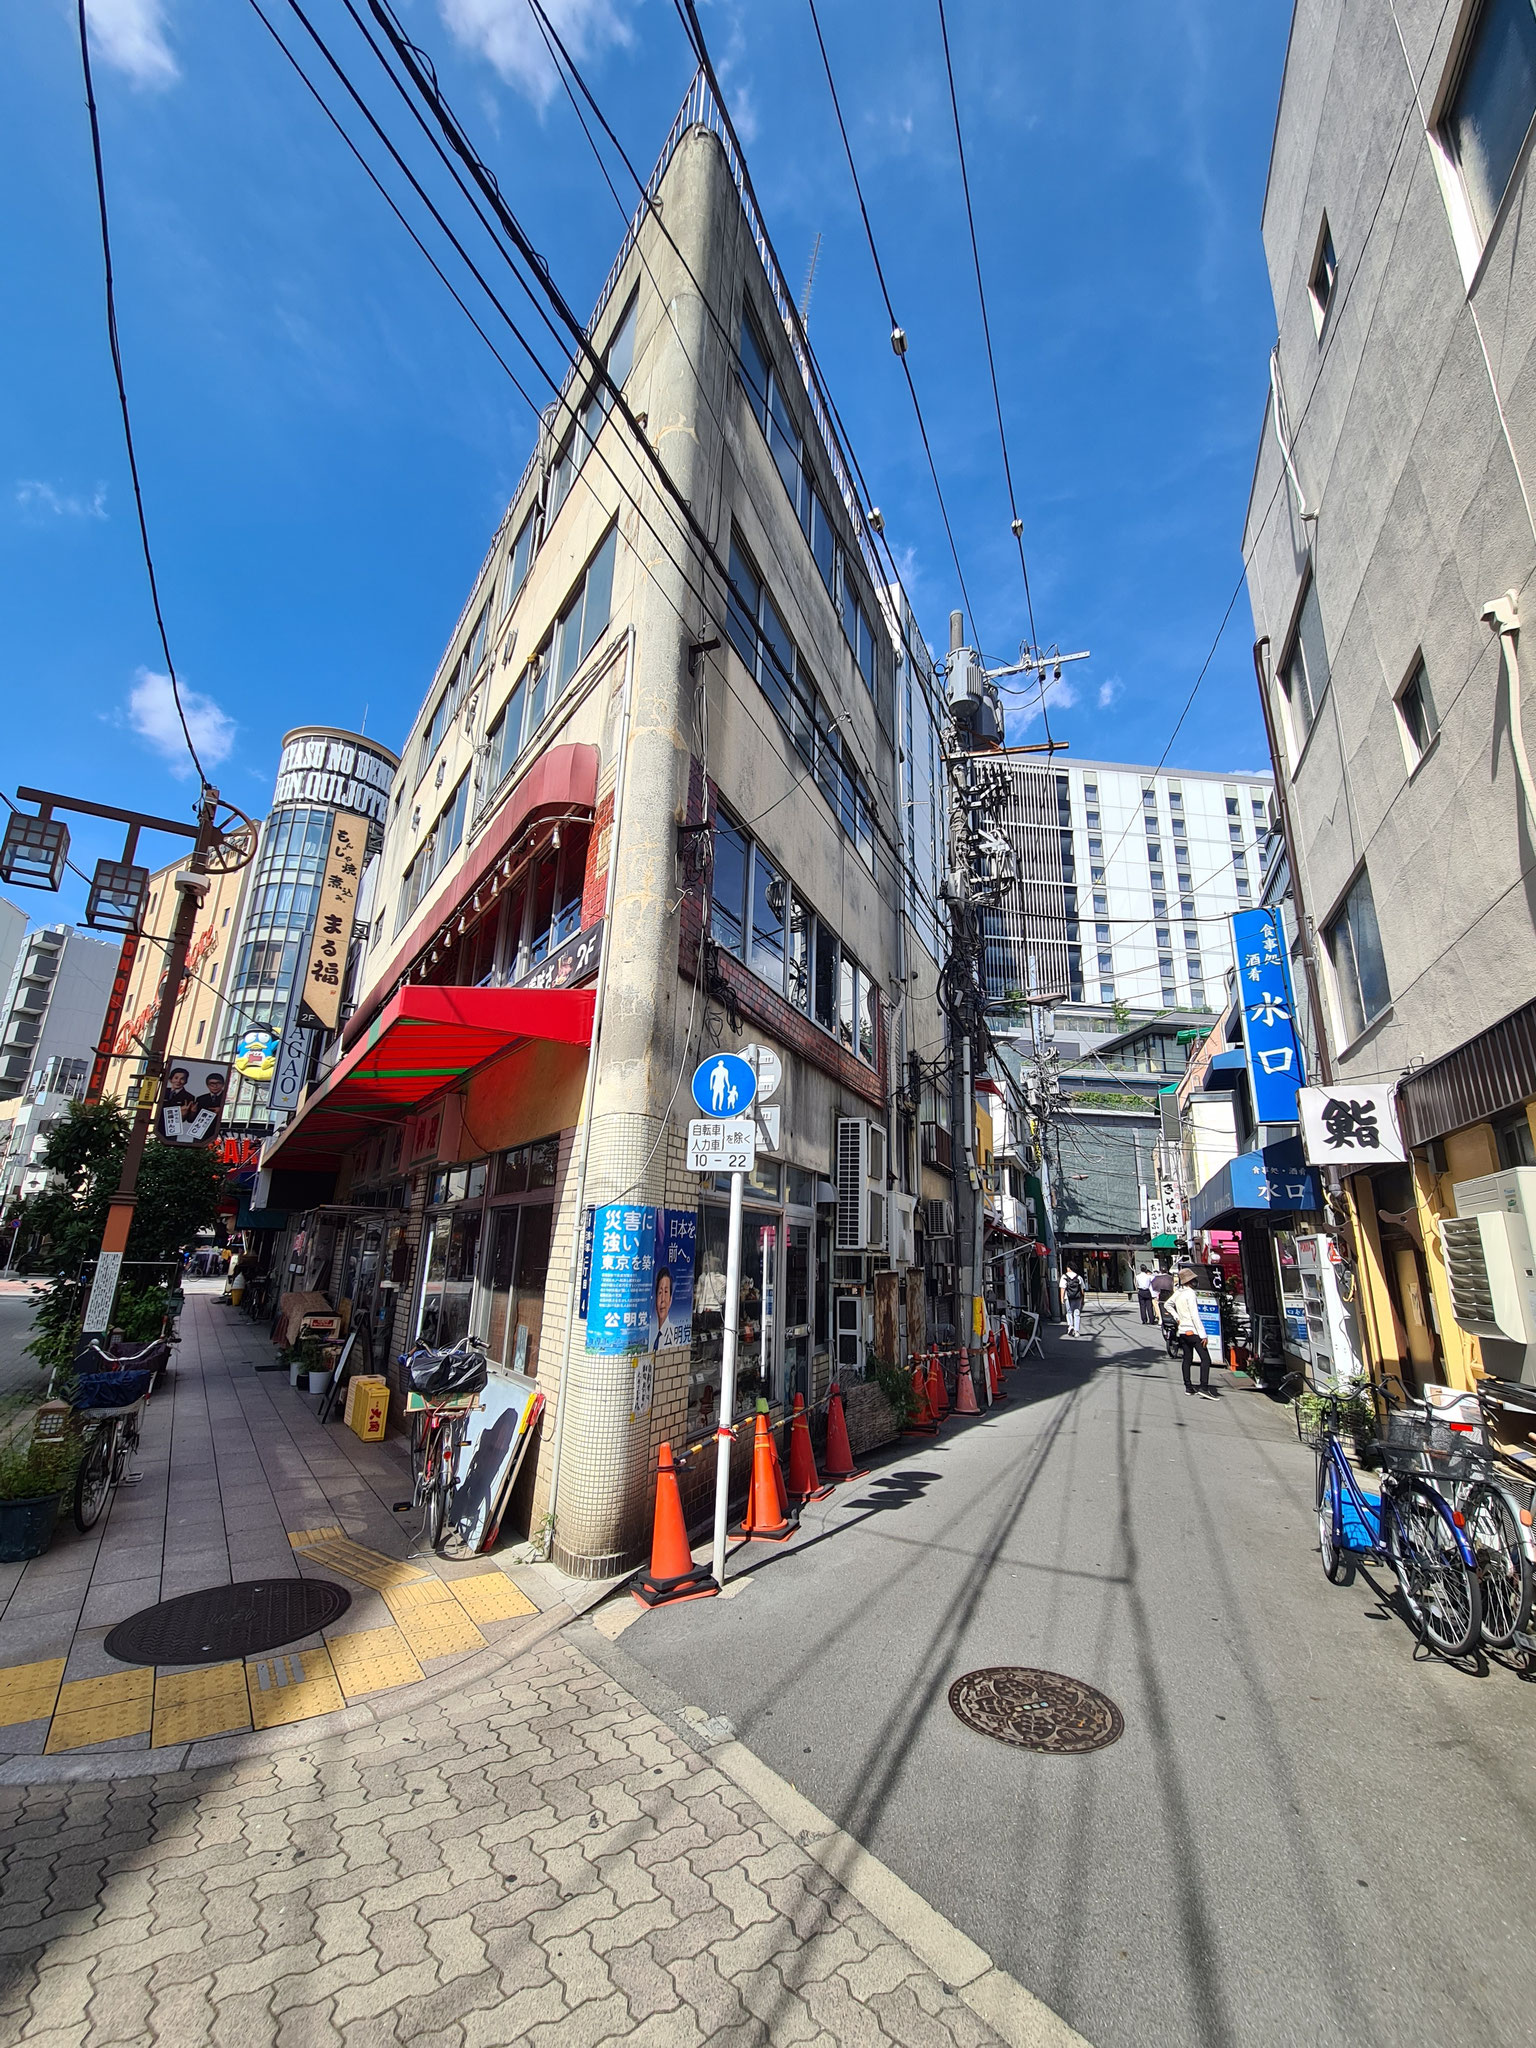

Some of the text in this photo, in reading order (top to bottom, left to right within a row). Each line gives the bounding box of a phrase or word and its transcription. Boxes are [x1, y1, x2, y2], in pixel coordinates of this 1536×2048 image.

[326, 743, 356, 775] NO
[311, 914, 343, 986] まる福
[575, 935, 597, 974] 2F
[1260, 923, 1282, 966] 食事処
[1245, 953, 1262, 982] 酒肴
[301, 1012, 315, 1022] 2F
[1251, 991, 1293, 1075] 水口
[692, 1124, 751, 1144] 自転車 を除く
[1321, 1098, 1380, 1150] 鮨
[691, 1139, 721, 1151] 人力車
[729, 1154, 746, 1167] 22
[1257, 1180, 1305, 1201] 水口
[604, 1209, 653, 1231] 災害に
[670, 1219, 697, 1240] 日本を、
[603, 1232, 639, 1253] 強い
[668, 1243, 691, 1264] 前へ。
[604, 1311, 649, 1328] 公明党
[663, 1325, 692, 1346] 公明党
